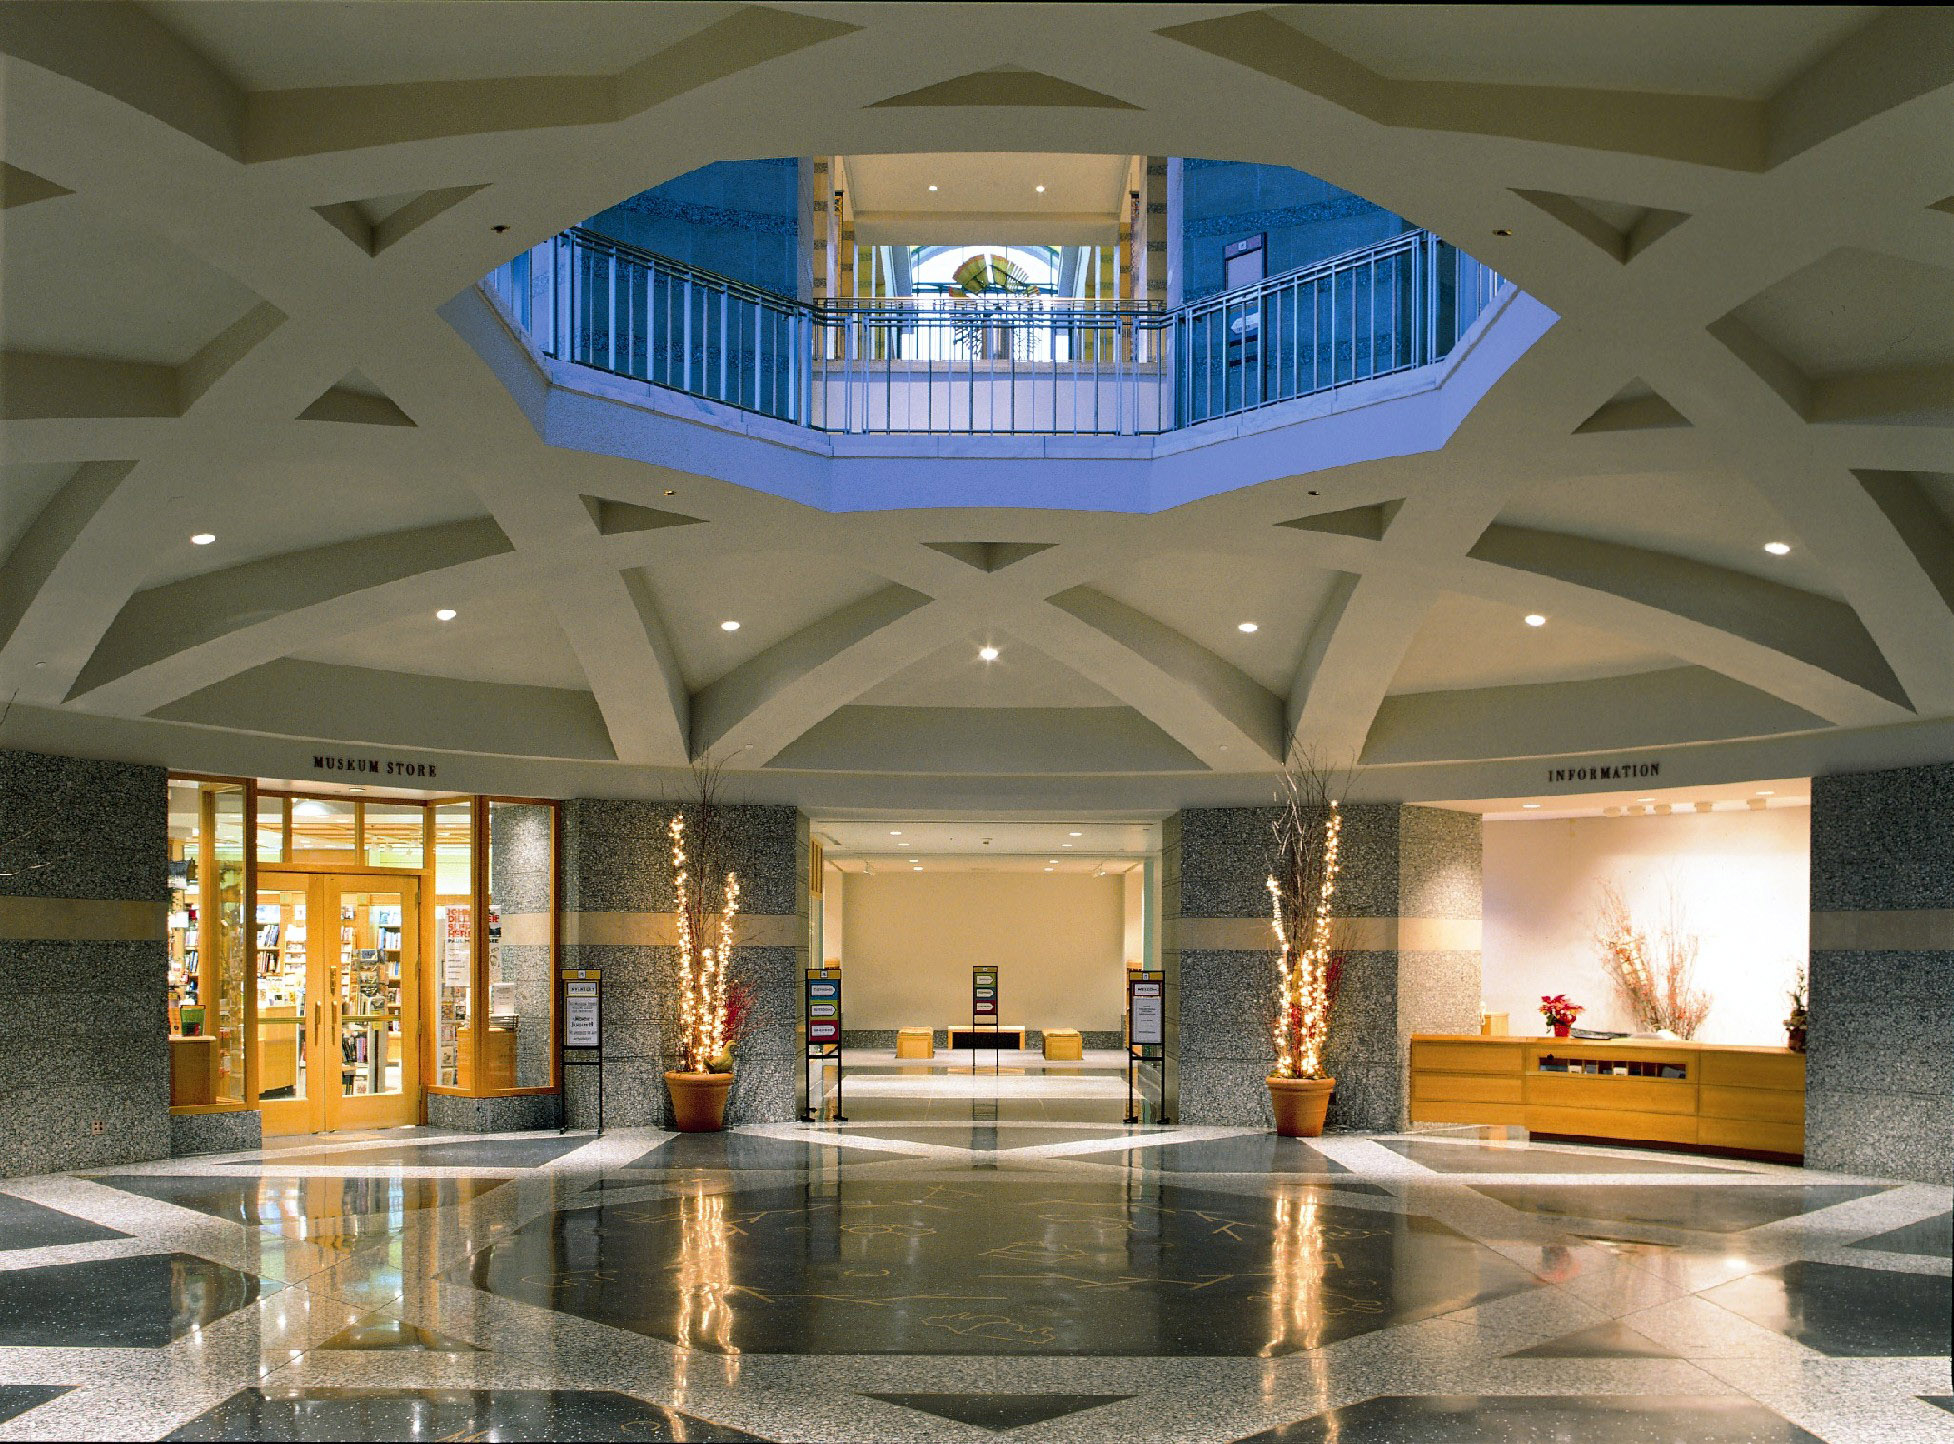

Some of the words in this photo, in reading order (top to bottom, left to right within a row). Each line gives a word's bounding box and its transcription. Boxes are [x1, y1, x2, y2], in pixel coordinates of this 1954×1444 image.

[313, 756, 379, 773] MUSEUM
[387, 762, 437, 777] STORE
[1548, 763, 1660, 782] INFORMATION
